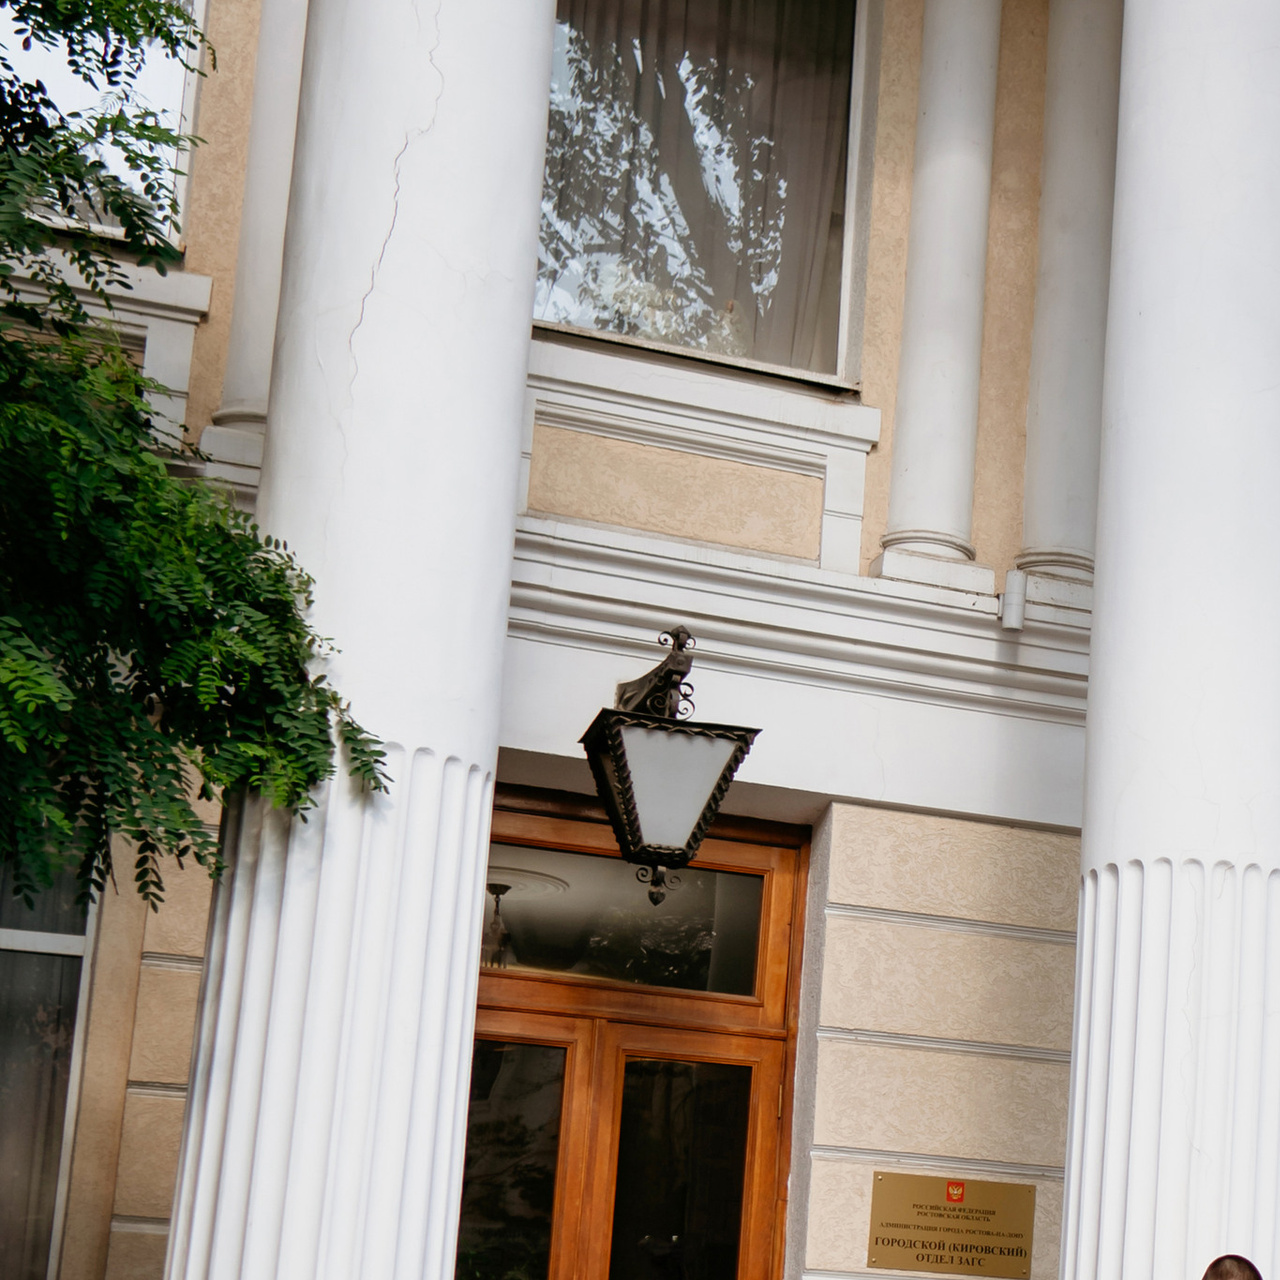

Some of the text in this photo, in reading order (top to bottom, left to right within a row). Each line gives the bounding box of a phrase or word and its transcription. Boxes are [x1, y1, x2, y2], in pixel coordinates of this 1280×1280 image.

[912, 1203, 996, 1215] РОССИЙСКАЯ ФЕДЕРАЦИЯ
[916, 1211, 991, 1222] РОСТОВСКАЯ ОБЛАСТЬ
[879, 1222, 938, 1232] АДМИНИСТРАЦИЯ
[875, 1236, 1027, 1259] ГОРОДСКОЙ (КИРОВСКИЙ)
[916, 1253, 986, 1268] ОТДЕЛ ЗАГС
